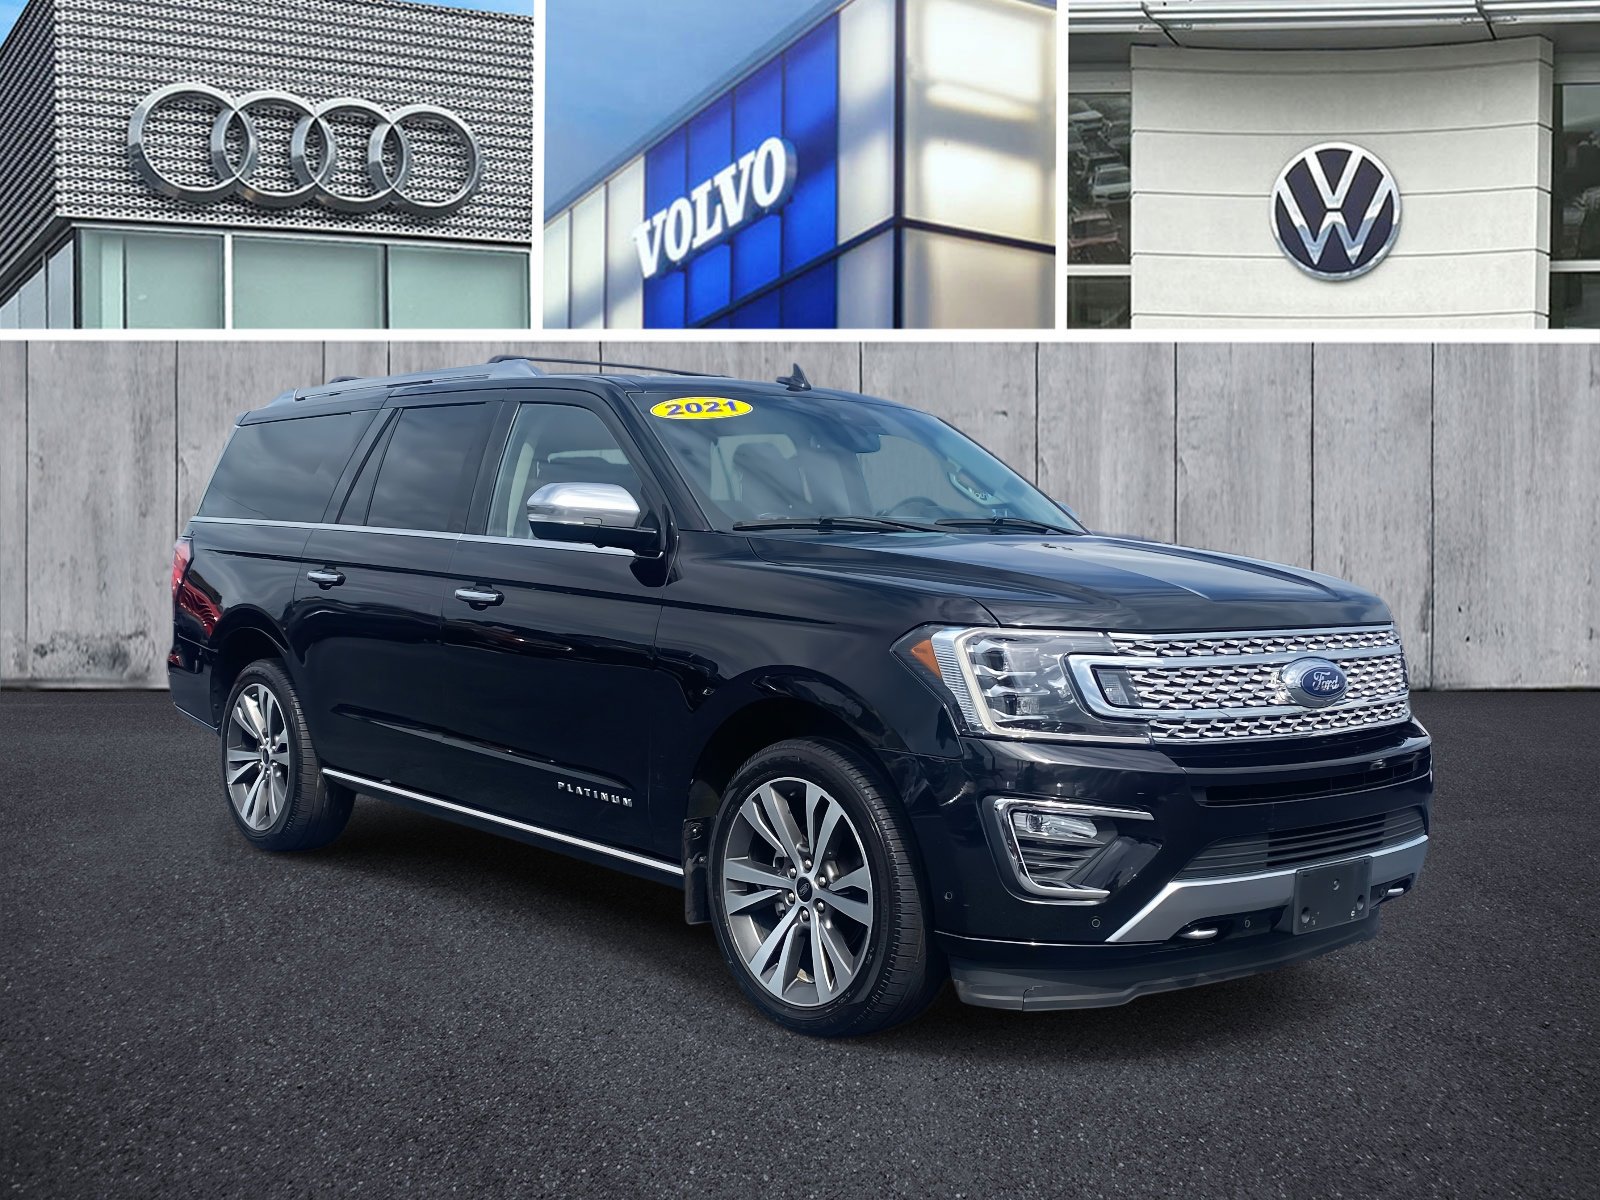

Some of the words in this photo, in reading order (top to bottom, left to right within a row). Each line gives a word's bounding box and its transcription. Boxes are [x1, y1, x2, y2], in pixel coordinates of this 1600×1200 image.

[632, 136, 792, 279] VOLVO
[664, 400, 739, 416] 2021
[1312, 670, 1340, 692] Ford
[557, 781, 633, 808] PLATINUM
